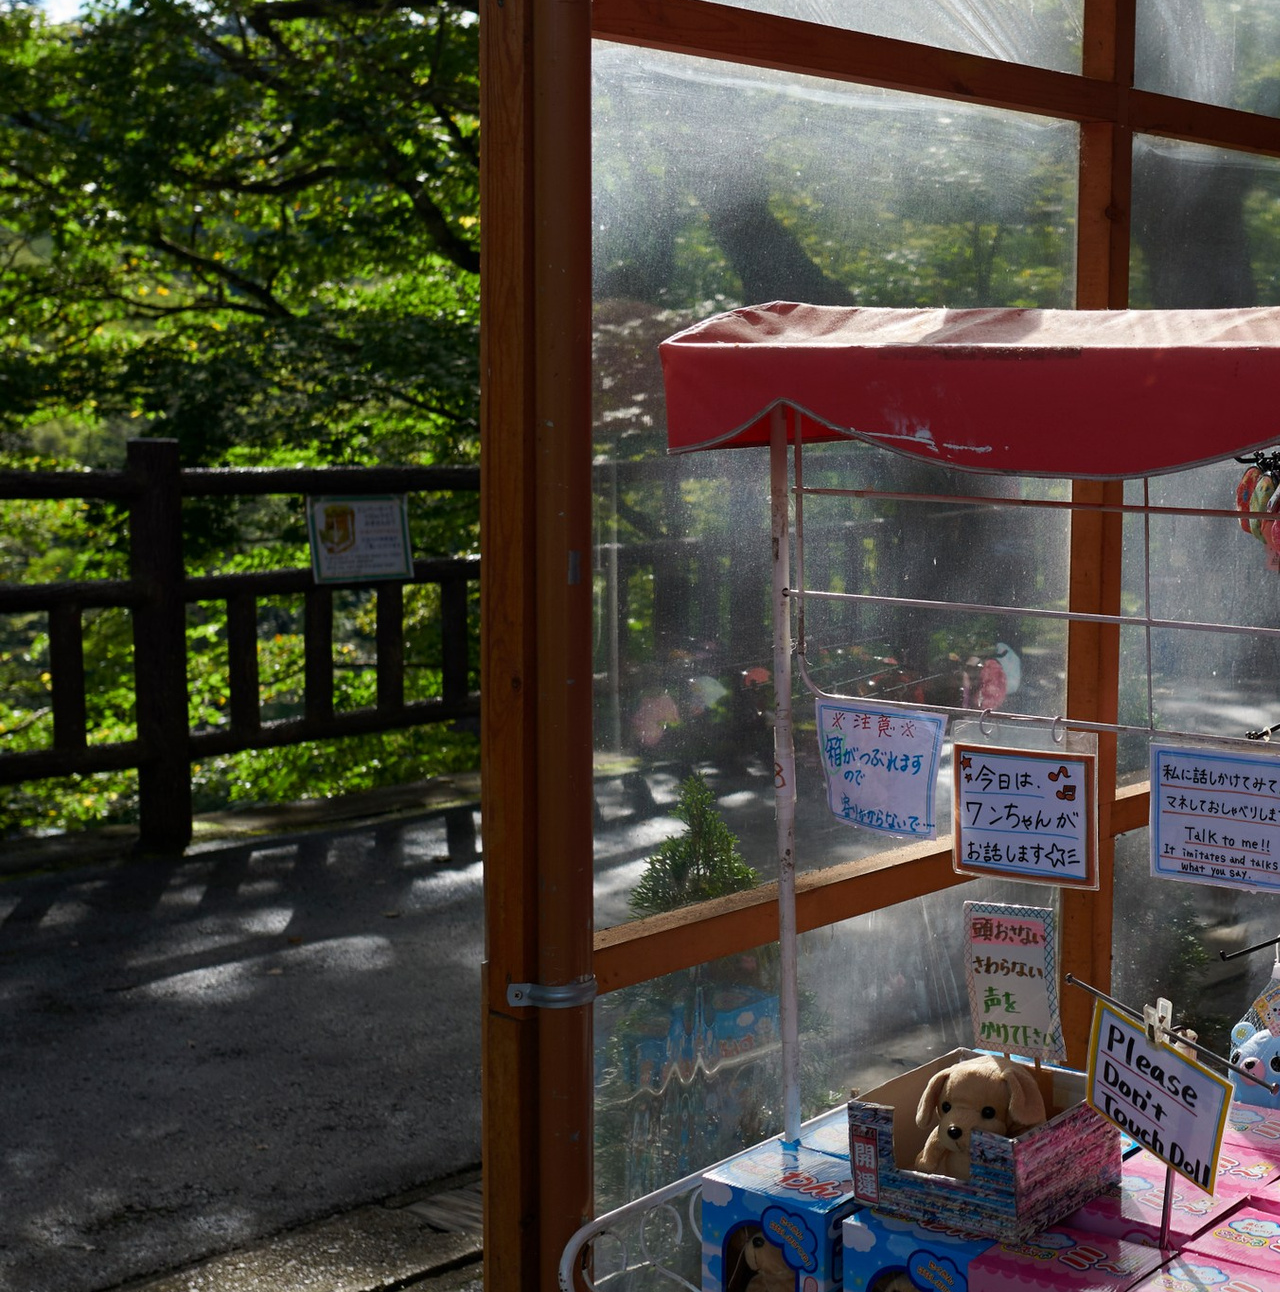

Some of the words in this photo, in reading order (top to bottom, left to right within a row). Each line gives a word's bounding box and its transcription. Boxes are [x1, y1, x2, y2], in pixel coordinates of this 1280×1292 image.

[1164, 844, 1175, 854] It
[1183, 848, 1226, 863] imitates
[1229, 856, 1245, 865] and
[1222, 835, 1235, 847] to
[1242, 839, 1270, 852] me!!
[1211, 867, 1225, 876] you
[1229, 869, 1251, 879] say.
[973, 956, 1044, 979] さわらない
[984, 986, 1021, 1013] 声を
[1107, 1024, 1198, 1107] Please
[1104, 1061, 1167, 1121] Don't
[1102, 1091, 1164, 1156] Touch
[1170, 1142, 1211, 1188] Doll
